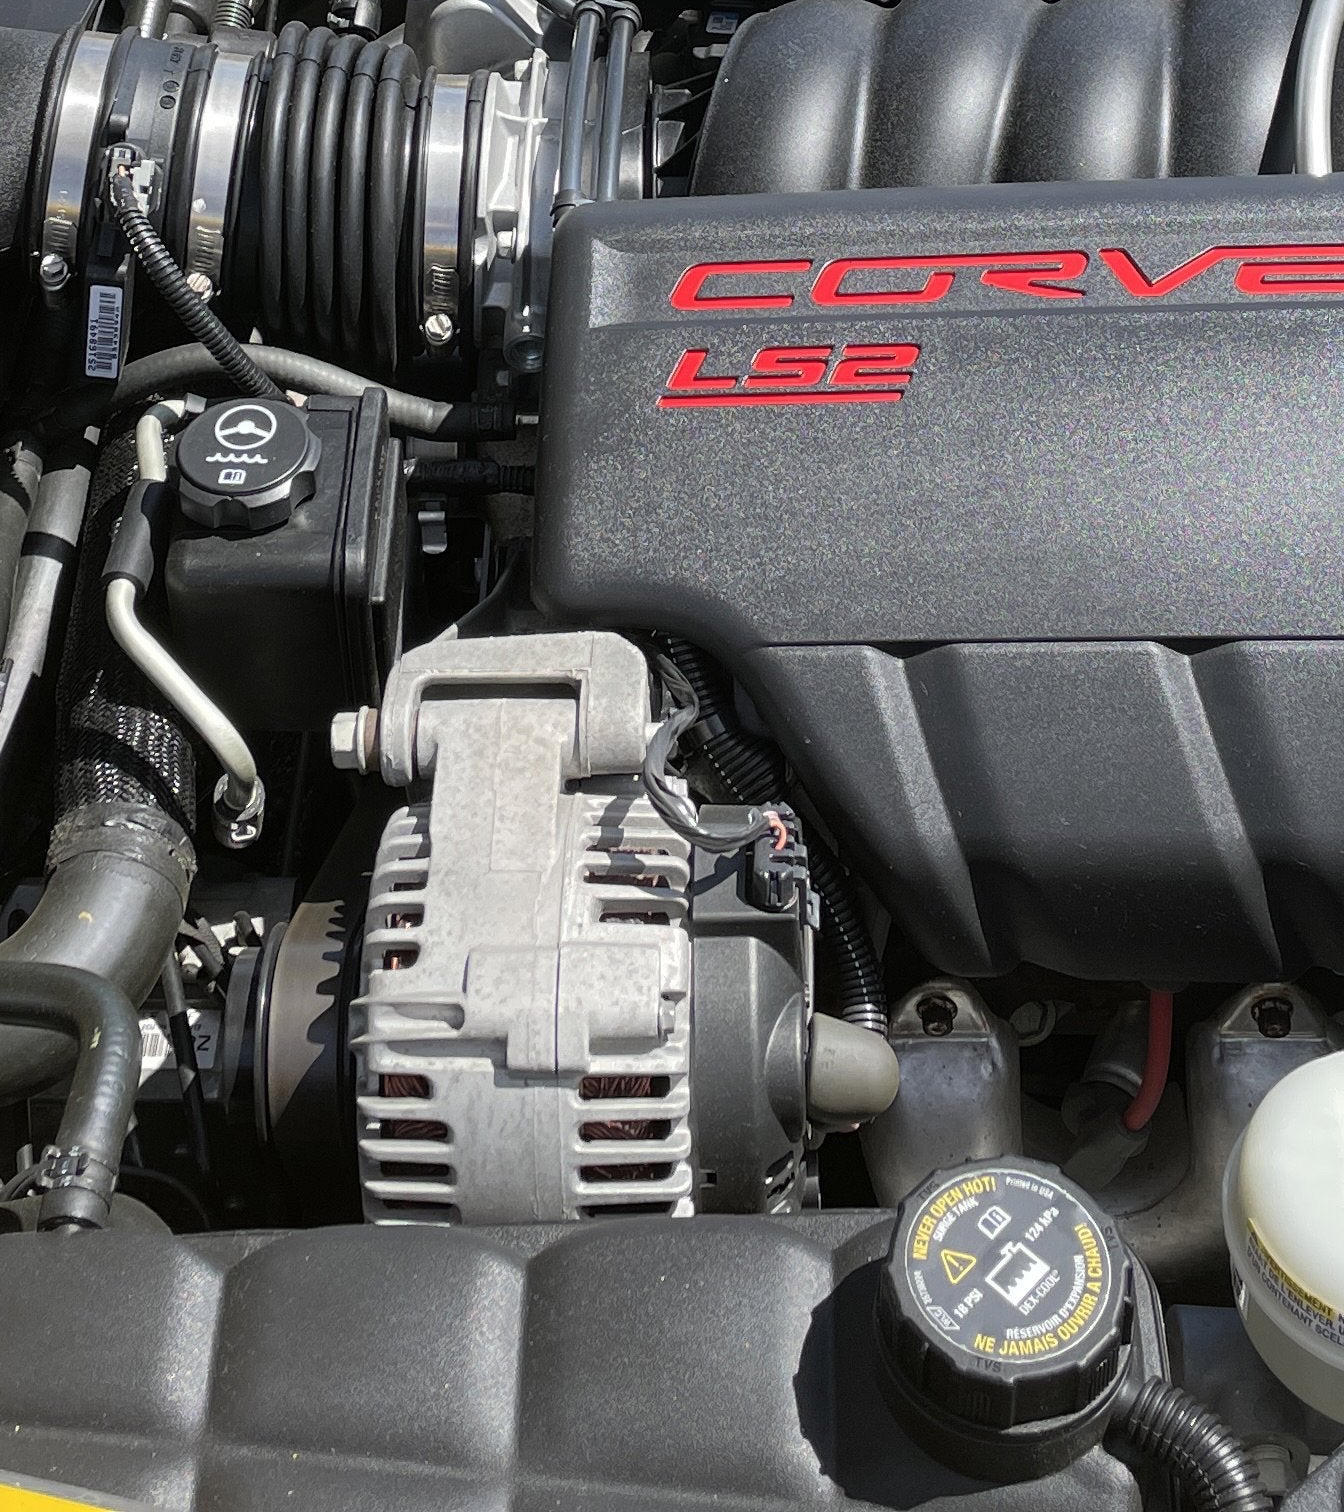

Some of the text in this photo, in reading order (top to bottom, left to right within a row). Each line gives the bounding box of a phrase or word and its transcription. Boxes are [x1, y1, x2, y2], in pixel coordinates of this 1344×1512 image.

[665, 343, 922, 392] LS2
[912, 1175, 996, 1260] NEVER OPEN HOT!
[932, 1196, 979, 1242] SURGE TANK
[1024, 1206, 1059, 1242] 124 kPa
[1074, 1223, 1103, 1278] CHAUD!
[953, 1303, 969, 1319] 18
[963, 1288, 984, 1309] PSI
[1057, 1293, 1099, 1341] OUVRIR
[1261, 1273, 1314, 1328] CONTENANT
[974, 1334, 996, 1353] NE
[999, 1333, 1059, 1356] JAMAIS
[1006, 1314, 1063, 1340] RÉSERVOIR
